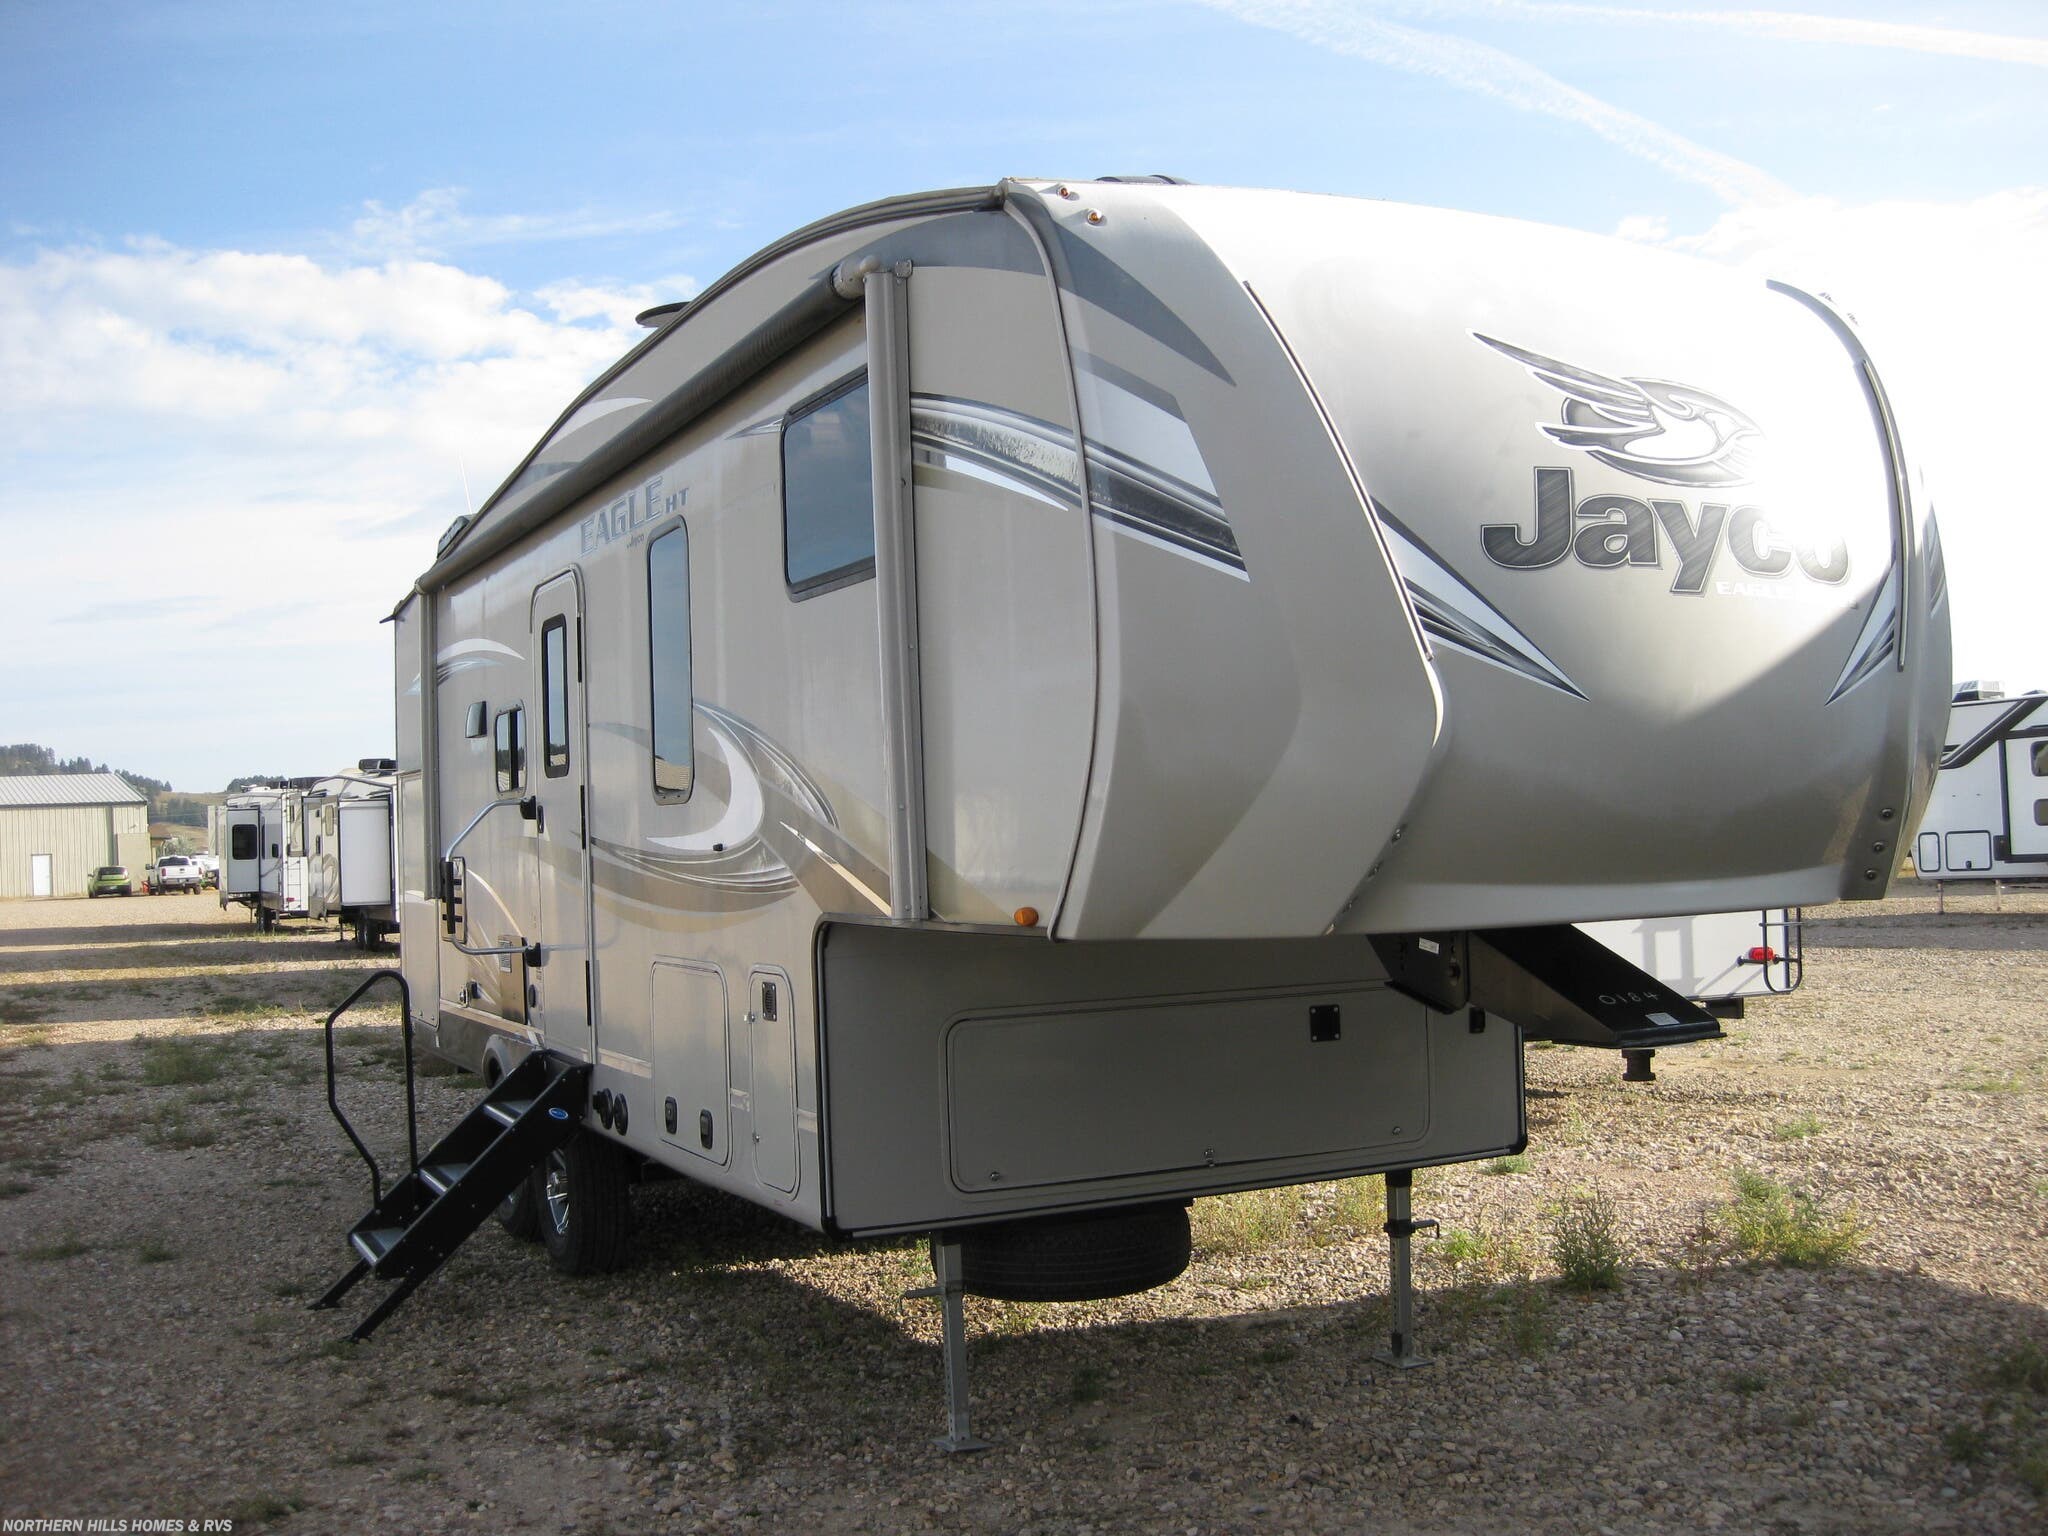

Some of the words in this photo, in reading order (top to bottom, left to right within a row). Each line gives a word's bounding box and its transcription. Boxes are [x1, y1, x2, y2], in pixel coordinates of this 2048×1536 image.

[580, 475, 664, 559] EAGLE
[665, 487, 689, 514] HT
[1480, 465, 1851, 598] Jayco
